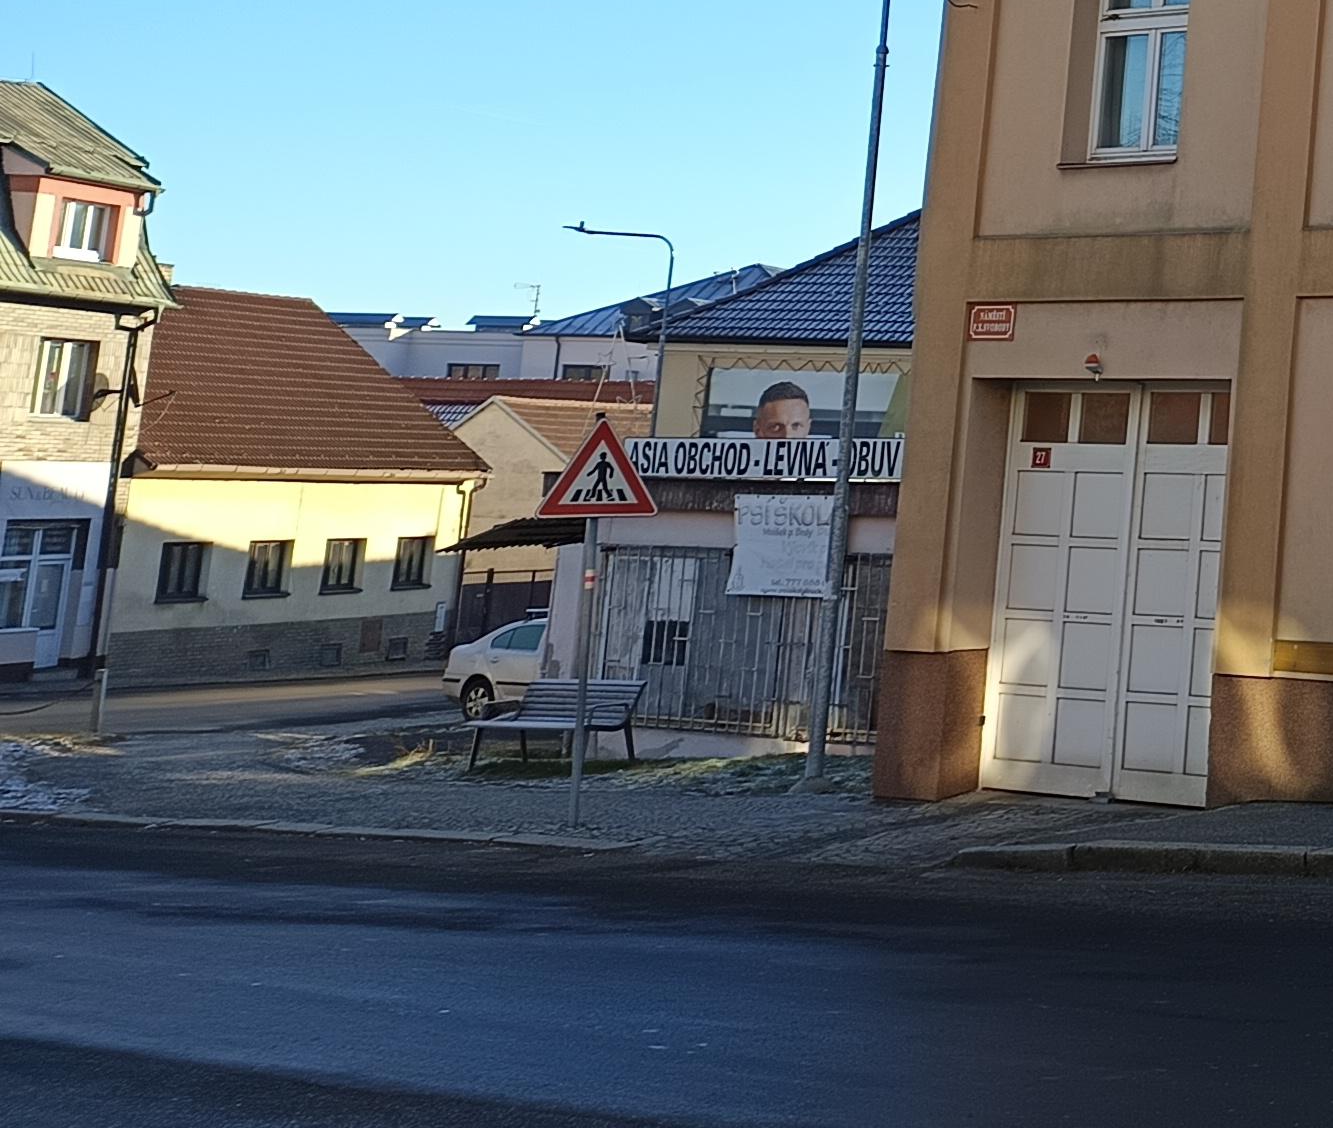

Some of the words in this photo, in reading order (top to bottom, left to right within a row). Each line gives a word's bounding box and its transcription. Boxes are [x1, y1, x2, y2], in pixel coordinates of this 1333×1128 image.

[629, 441, 669, 475] ASIA
[674, 441, 750, 476] OBCHOD
[763, 439, 830, 477] LEVNÁ
[1035, 451, 1046, 464] 27
[738, 497, 772, 526] PSÍ
[774, 497, 831, 527] ŠKOL
